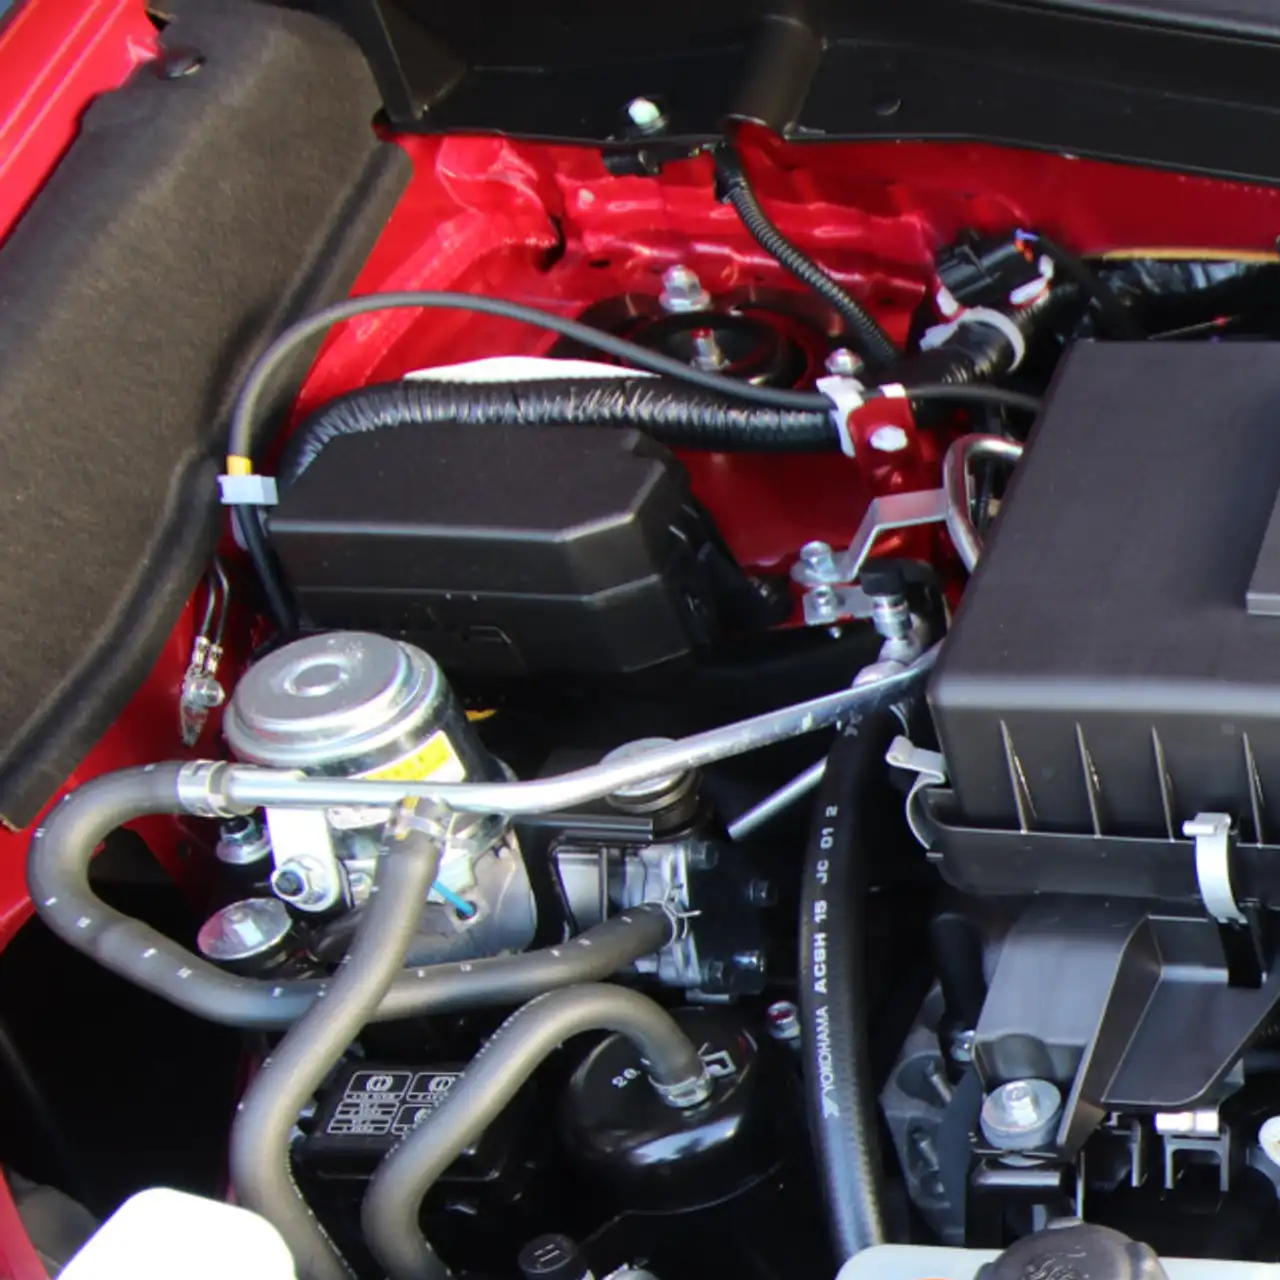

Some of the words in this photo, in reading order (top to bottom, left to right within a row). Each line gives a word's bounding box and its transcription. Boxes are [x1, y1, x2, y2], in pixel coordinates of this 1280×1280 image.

[816, 860, 829, 884] JC
[814, 901, 827, 923] 15
[816, 1005, 834, 1096] YOKOHAMA
